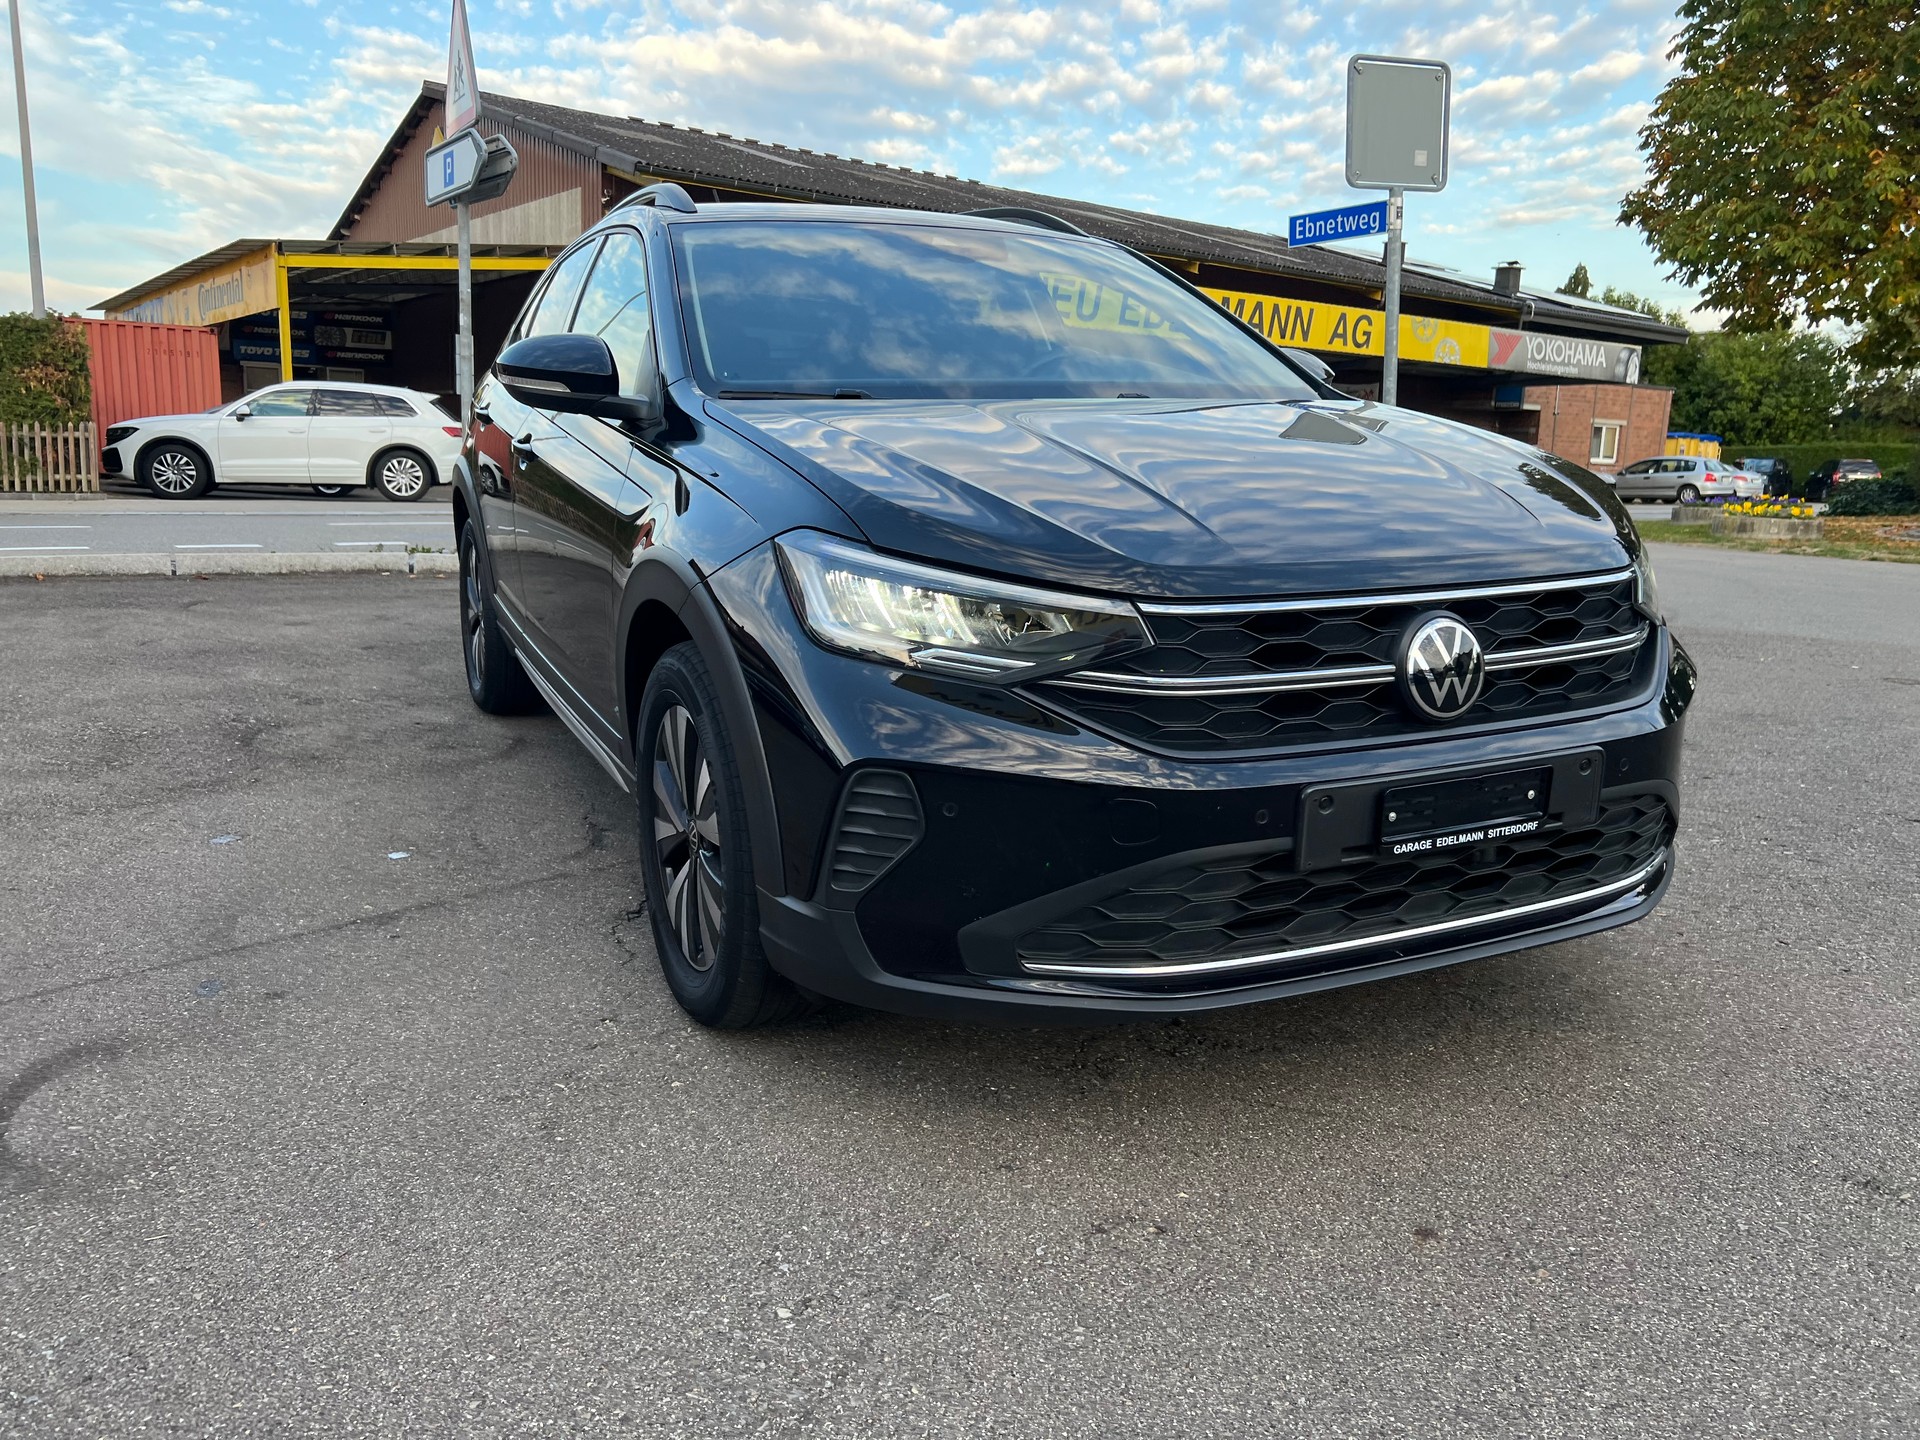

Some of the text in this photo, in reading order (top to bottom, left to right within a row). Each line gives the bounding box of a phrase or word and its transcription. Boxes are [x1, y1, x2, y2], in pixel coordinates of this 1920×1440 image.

[446, 157, 452, 183] P
[1295, 211, 1380, 239] Ebnetweg
[198, 268, 244, 322] Continental
[1328, 312, 1374, 349] AG
[239, 345, 273, 356] TOYO
[1525, 336, 1607, 368] YOKOHAMA
[1393, 821, 1539, 855] GARAGE EDELMANN SITTERDORF
